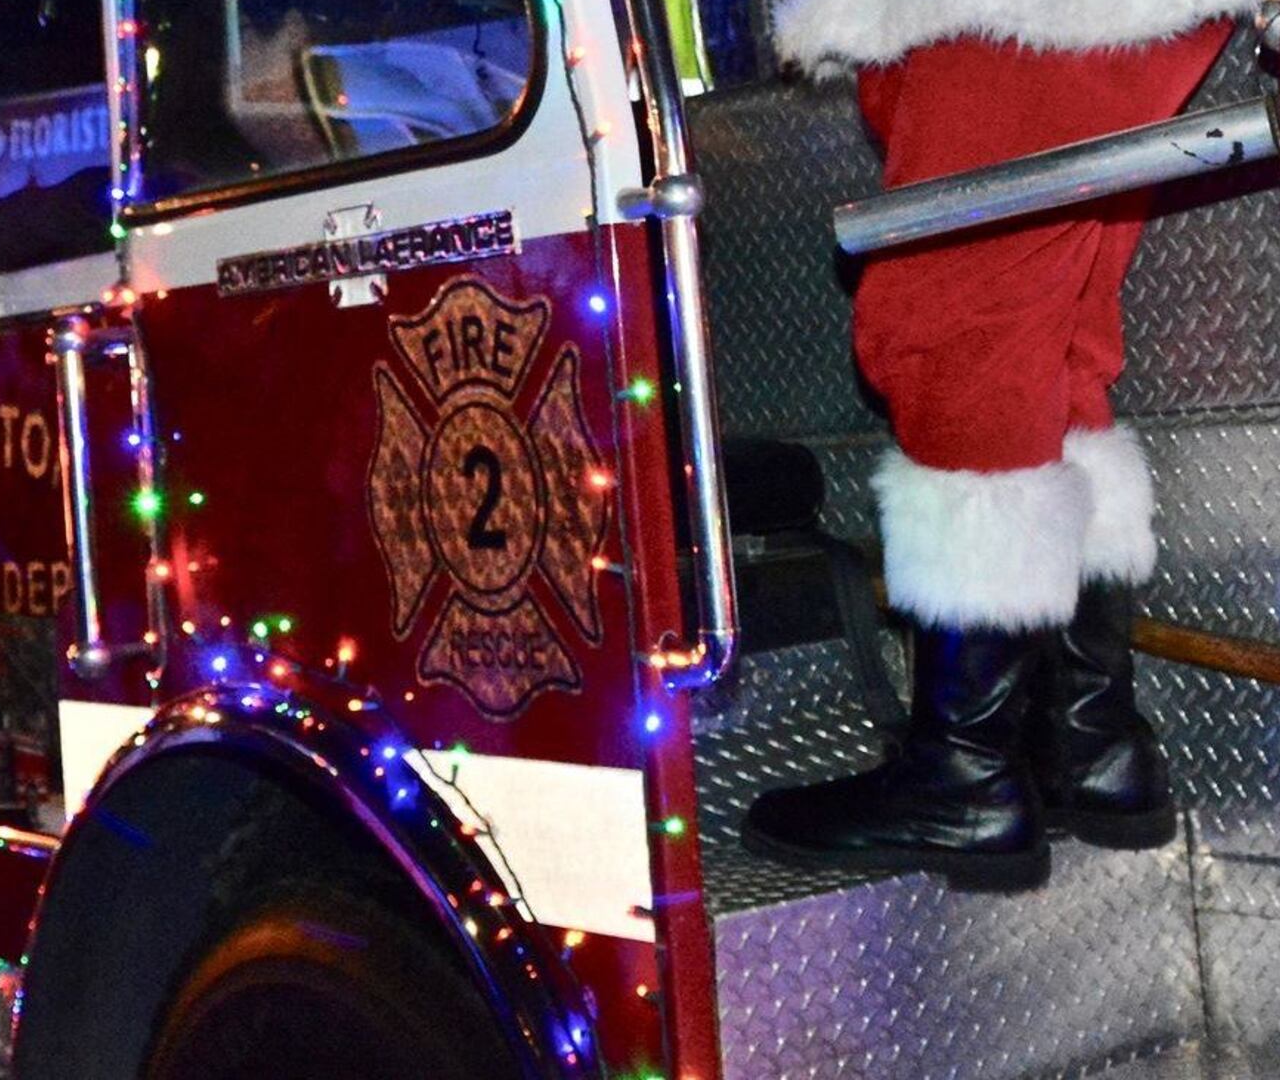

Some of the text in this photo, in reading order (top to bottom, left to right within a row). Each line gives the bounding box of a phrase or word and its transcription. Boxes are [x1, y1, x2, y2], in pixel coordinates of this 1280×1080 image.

[422, 314, 516, 386] FIRE
[463, 444, 507, 550] 2
[3, 560, 72, 616] DEP
[449, 631, 546, 670] RESCUE
